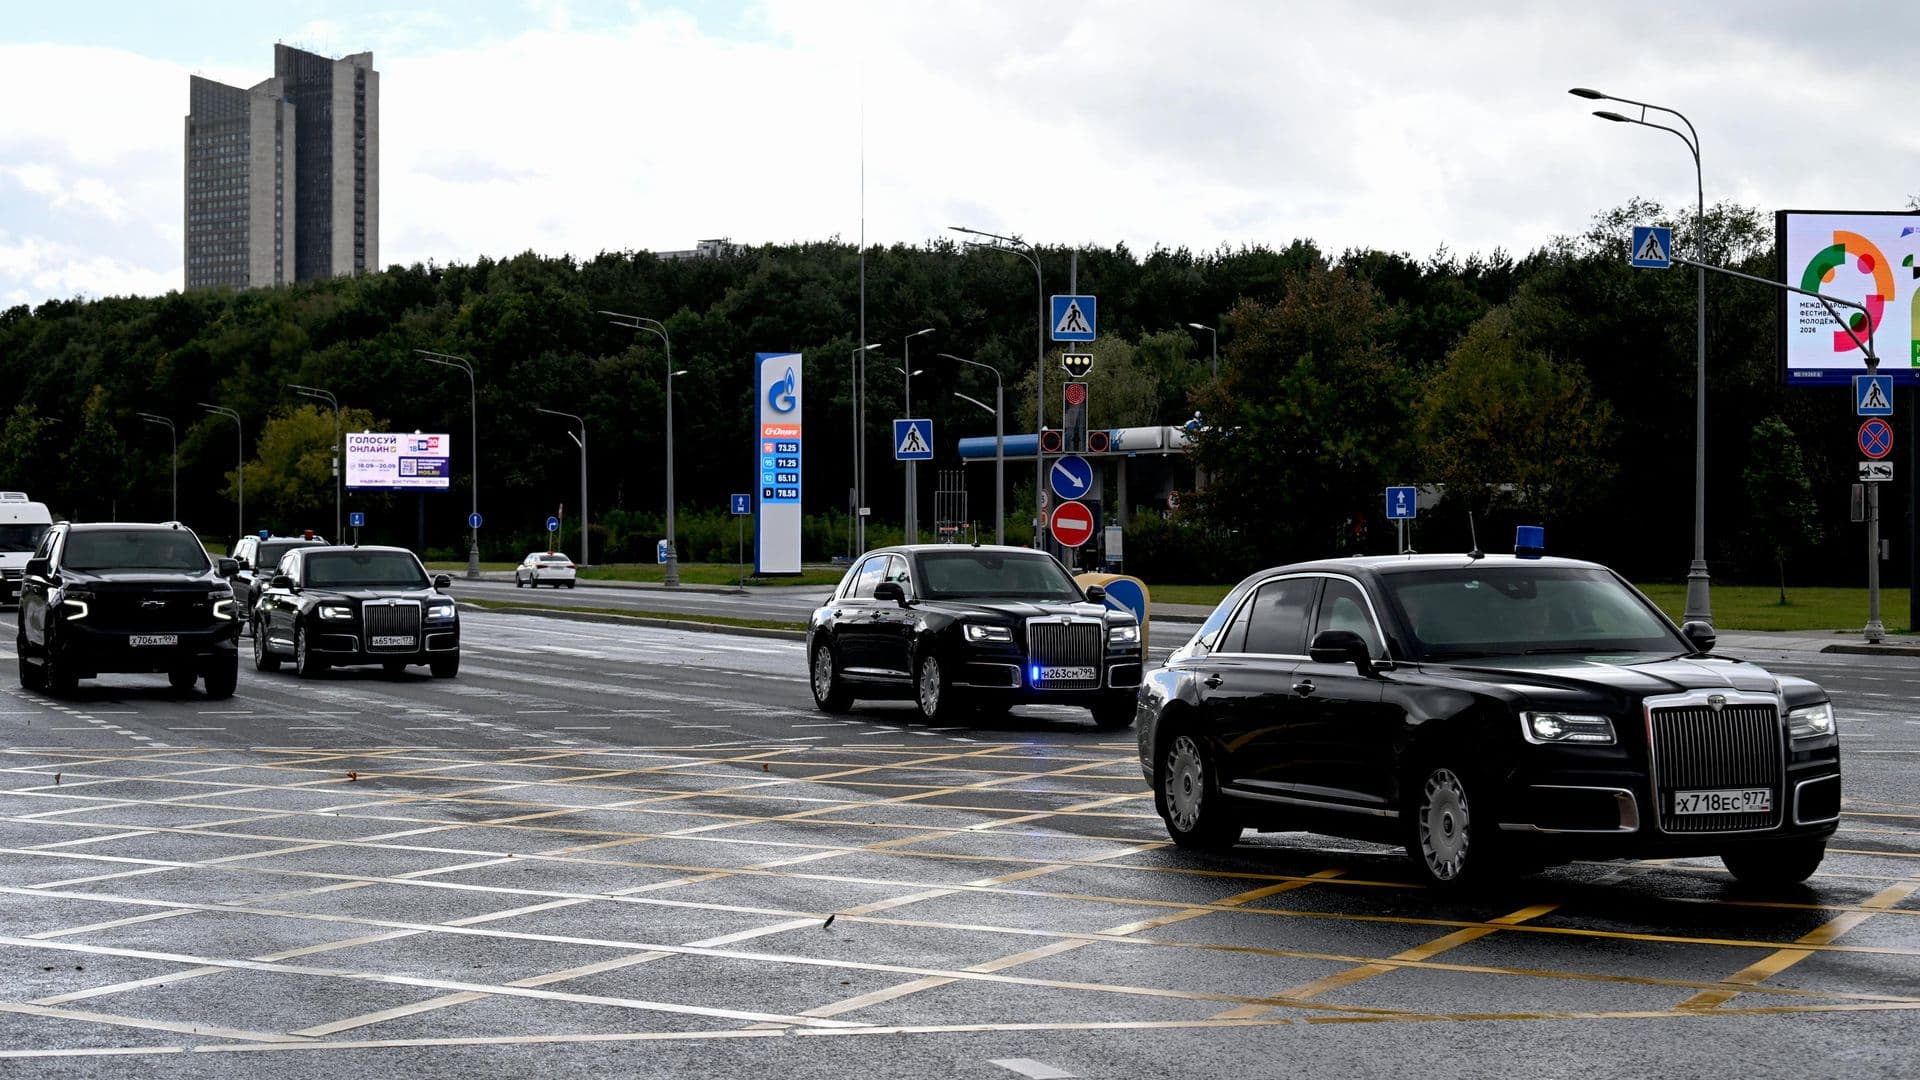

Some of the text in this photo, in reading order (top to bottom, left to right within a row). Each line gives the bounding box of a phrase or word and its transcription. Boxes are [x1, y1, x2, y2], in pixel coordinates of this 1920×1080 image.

[349, 435, 397, 444] ГОЛОСУЙ
[349, 445, 390, 453] ОНЛАЙН
[778, 444, 797, 452] 73.25
[778, 459, 797, 467] 71.25
[777, 474, 797, 482] 65.18
[778, 489, 797, 497] 78.58
[1043, 668, 1079, 679] Н263СМ
[1680, 791, 1766, 812] Х718ЕС 977
